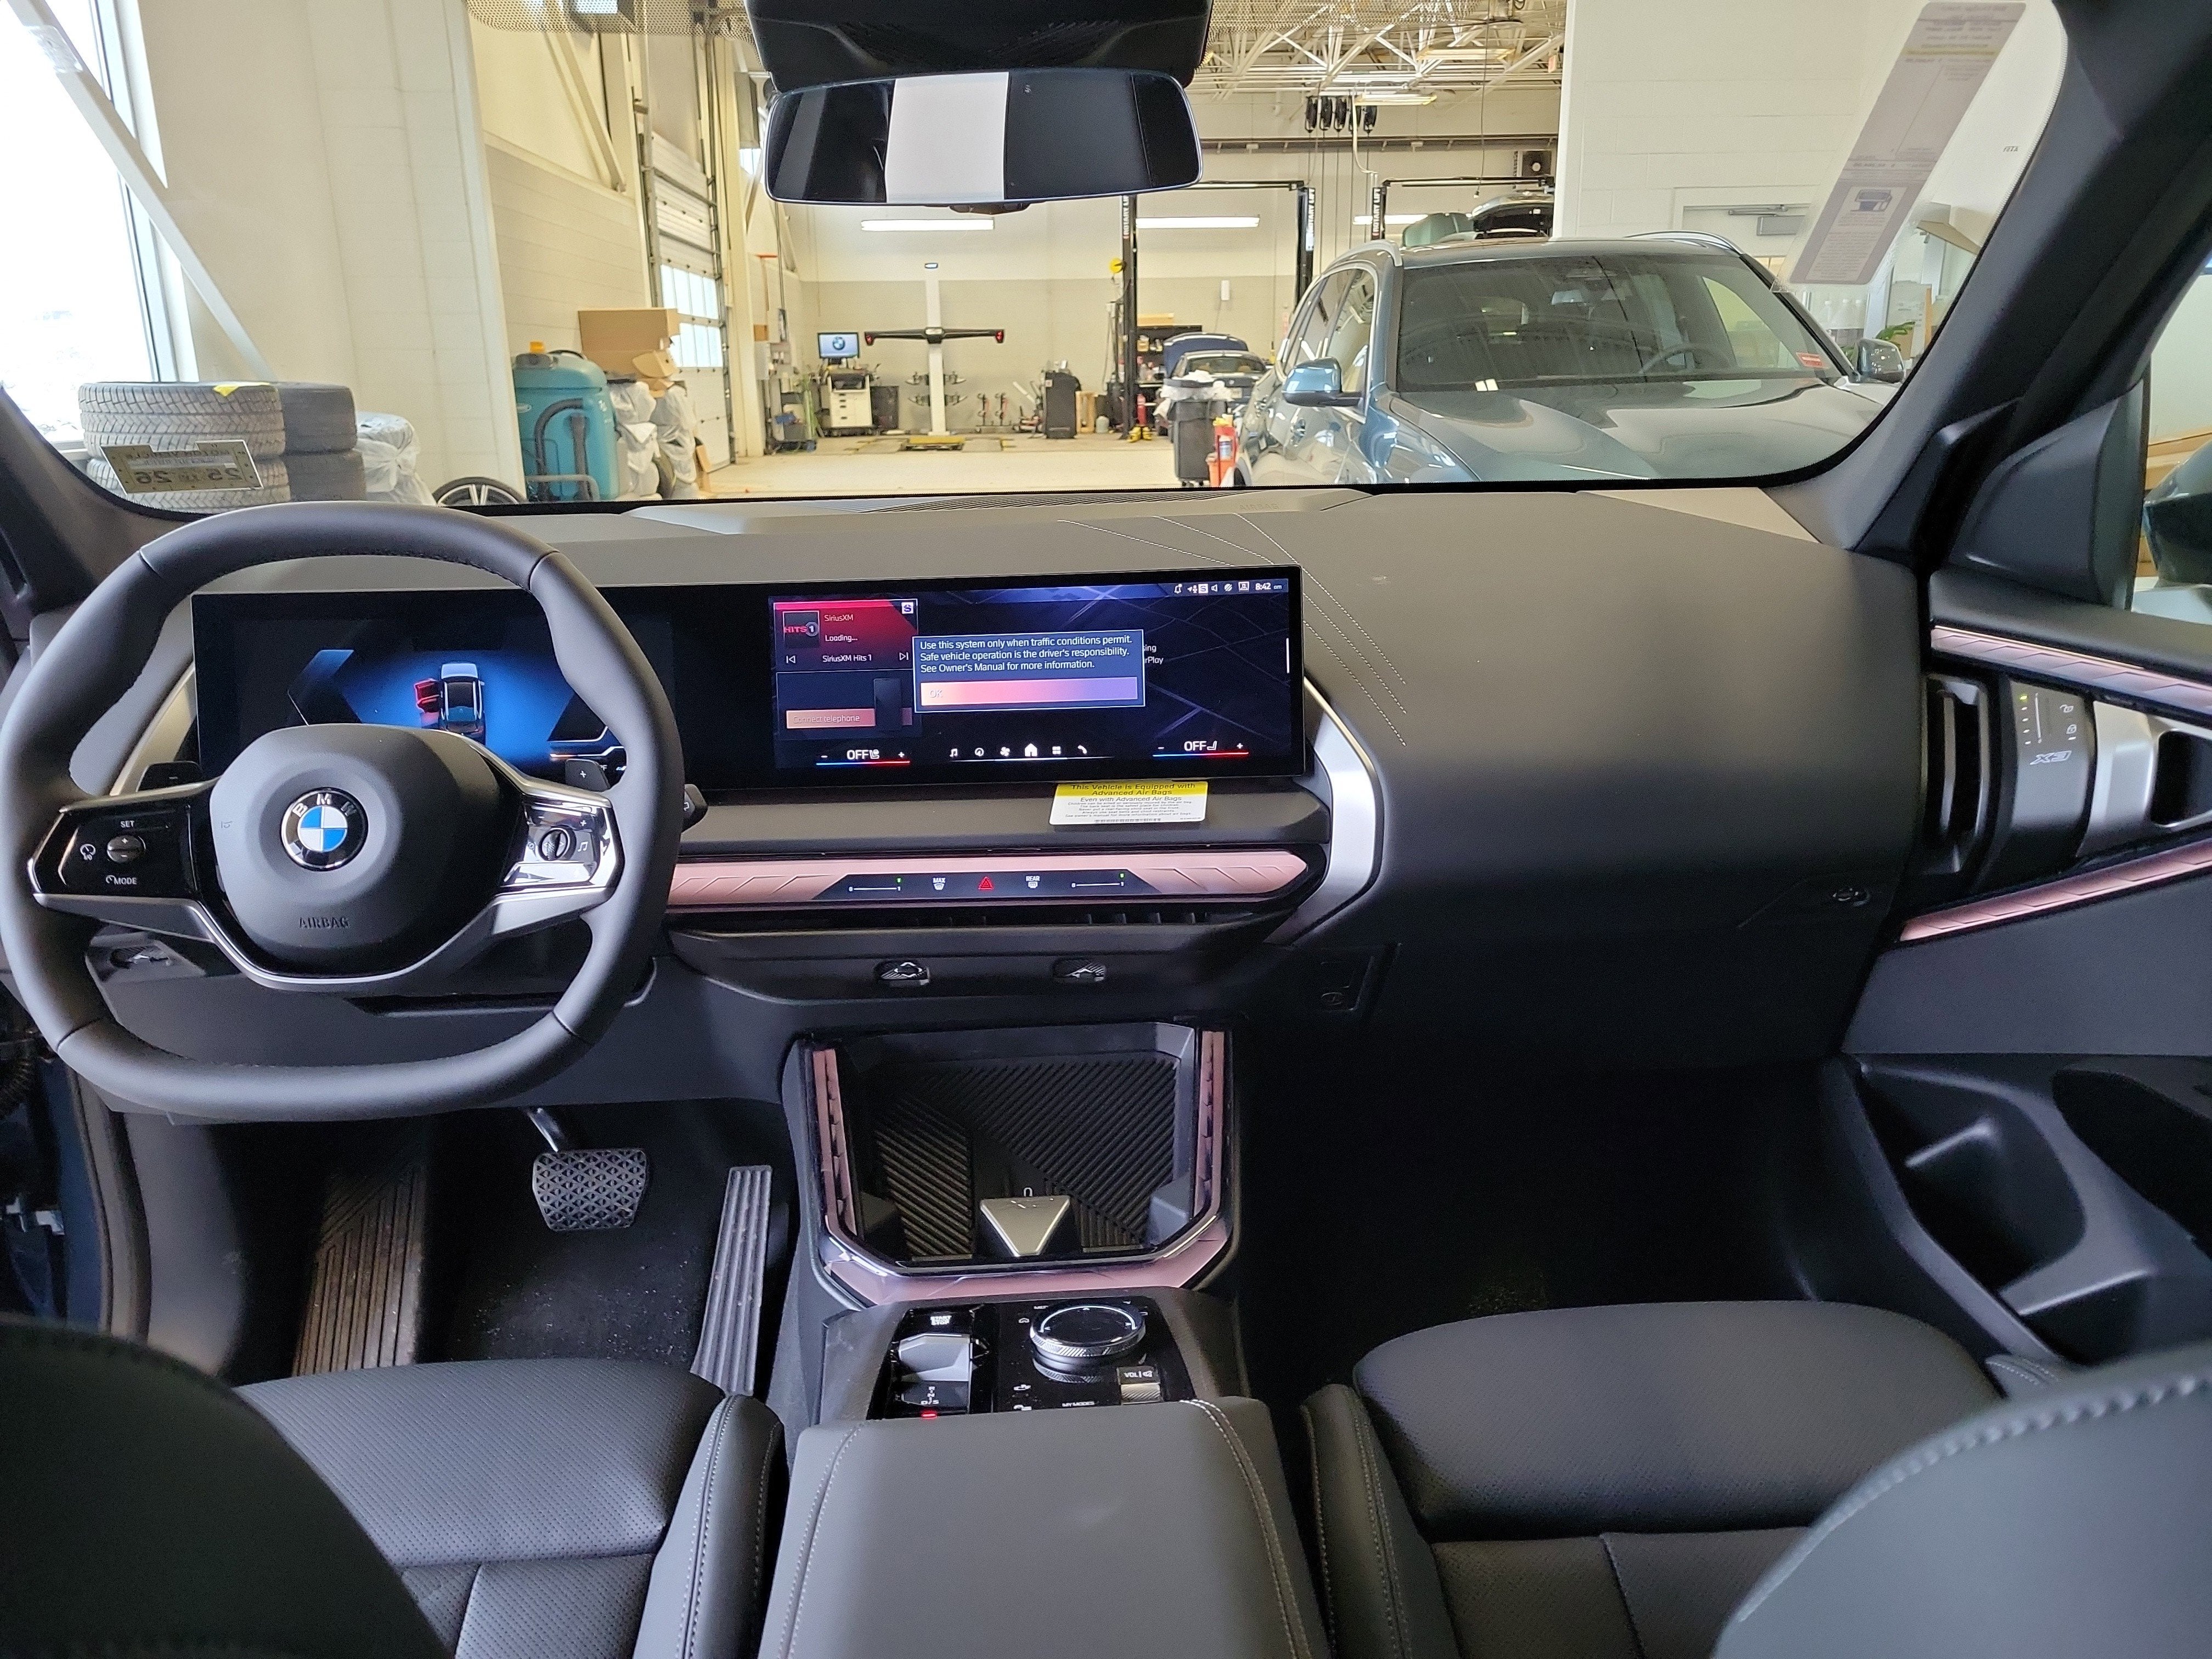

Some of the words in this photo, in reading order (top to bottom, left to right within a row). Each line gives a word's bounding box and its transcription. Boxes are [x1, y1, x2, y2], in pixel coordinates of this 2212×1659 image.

[920, 641, 936, 650] Use
[938, 641, 954, 649] this
[955, 640, 985, 650] system
[988, 639, 1005, 648] only
[1006, 639, 1029, 647] when
[1031, 637, 1055, 646] traffic
[1057, 636, 1101, 645] conditions
[1103, 635, 1132, 645] permit.
[920, 653, 939, 661] Safe
[940, 652, 970, 661] vehicle
[972, 651, 1012, 661] operation
[1014, 650, 1021, 658] is
[1023, 650, 1037, 658] the
[1039, 648, 1069, 657] driver's
[1071, 647, 1130, 658] responsibility.
[921, 664, 937, 673] See
[939, 664, 973, 672] Owner's
[974, 662, 1005, 672] Manual
[1007, 662, 1019, 670] for
[1044, 660, 1095, 669] information.
[930, 690, 943, 698] OK
[824, 715, 860, 724] telephone
[1184, 741, 1207, 751] OFF
[847, 749, 869, 760] OFF
[2030, 751, 2072, 765] X3
[292, 793, 358, 817] BMW
[300, 917, 350, 928] AIRBAG
